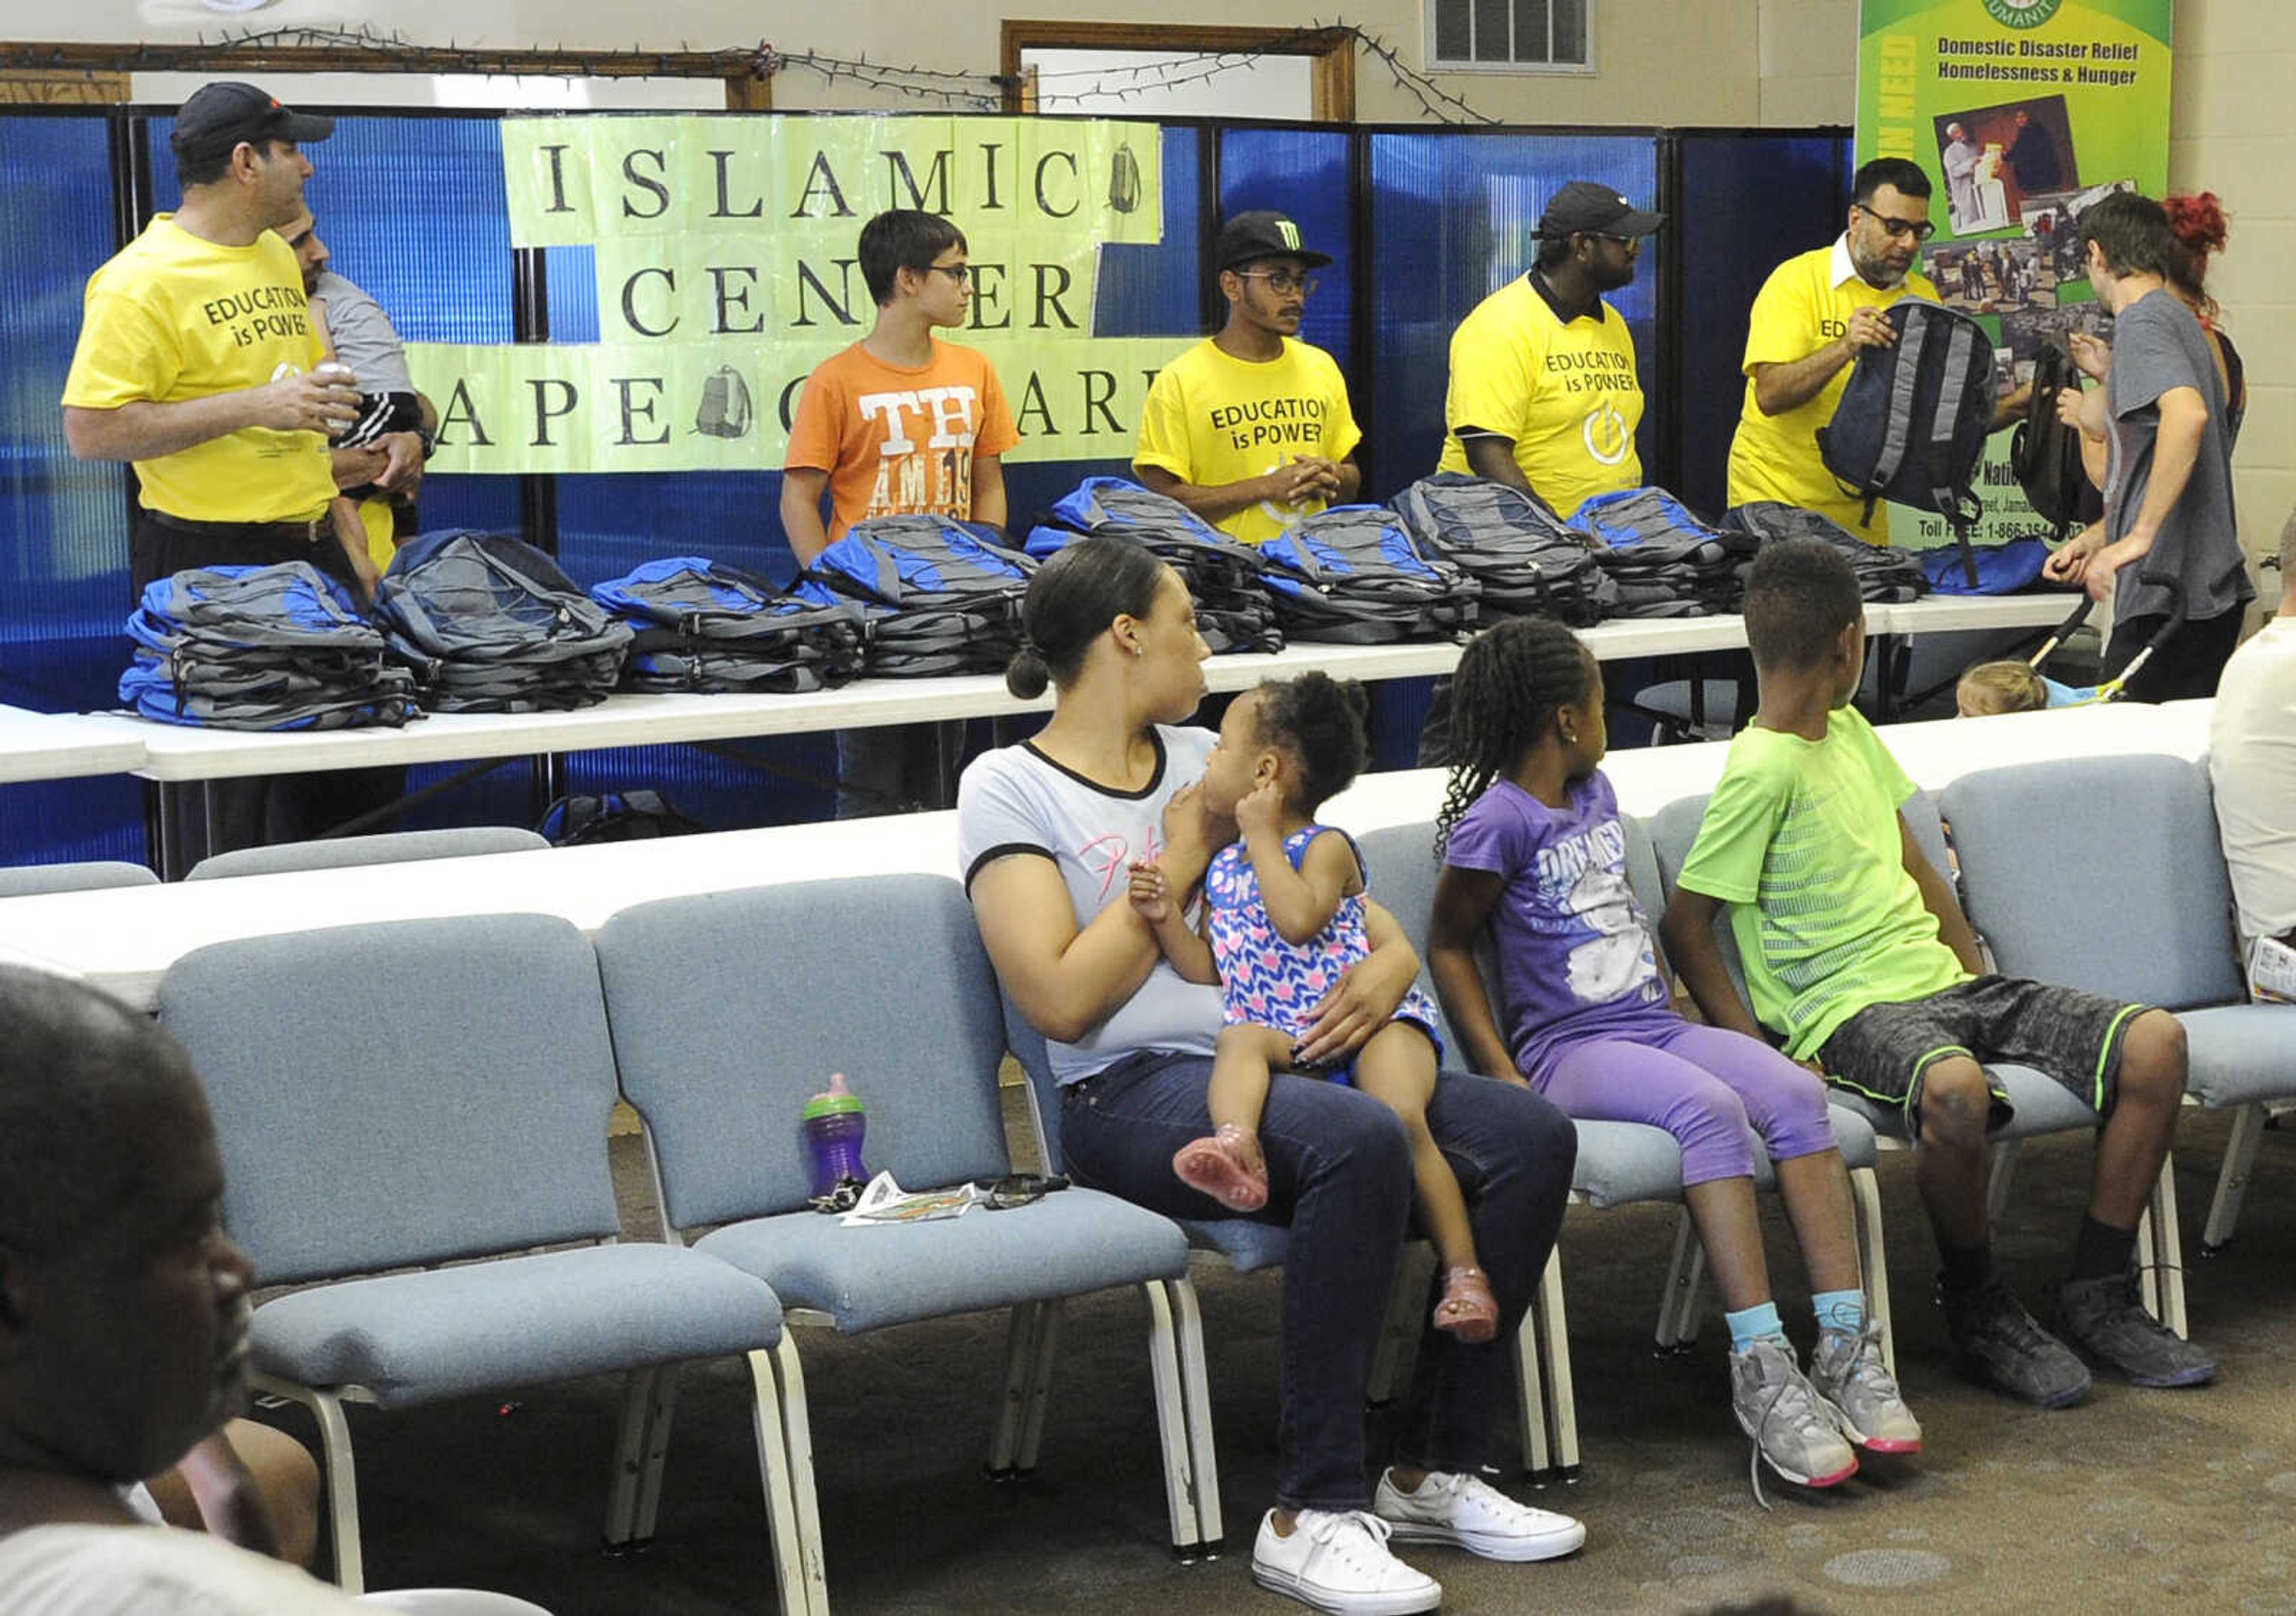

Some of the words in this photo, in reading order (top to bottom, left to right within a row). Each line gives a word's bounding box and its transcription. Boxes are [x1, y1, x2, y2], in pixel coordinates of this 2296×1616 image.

[1938, 36, 2016, 56] Domestic
[2020, 39, 2088, 59] Disaster
[2092, 42, 2139, 60] Relief
[1938, 62, 2059, 83] Homelessness
[2062, 67, 2073, 83] &
[2078, 65, 2136, 86] Hunger
[539, 144, 1080, 218] ISLAMIC
[622, 258, 1080, 337] CENER
[231, 325, 253, 347] is
[1565, 374, 1581, 392] is
[1231, 430, 1250, 450] is
[1918, 520, 1942, 536] Toll
